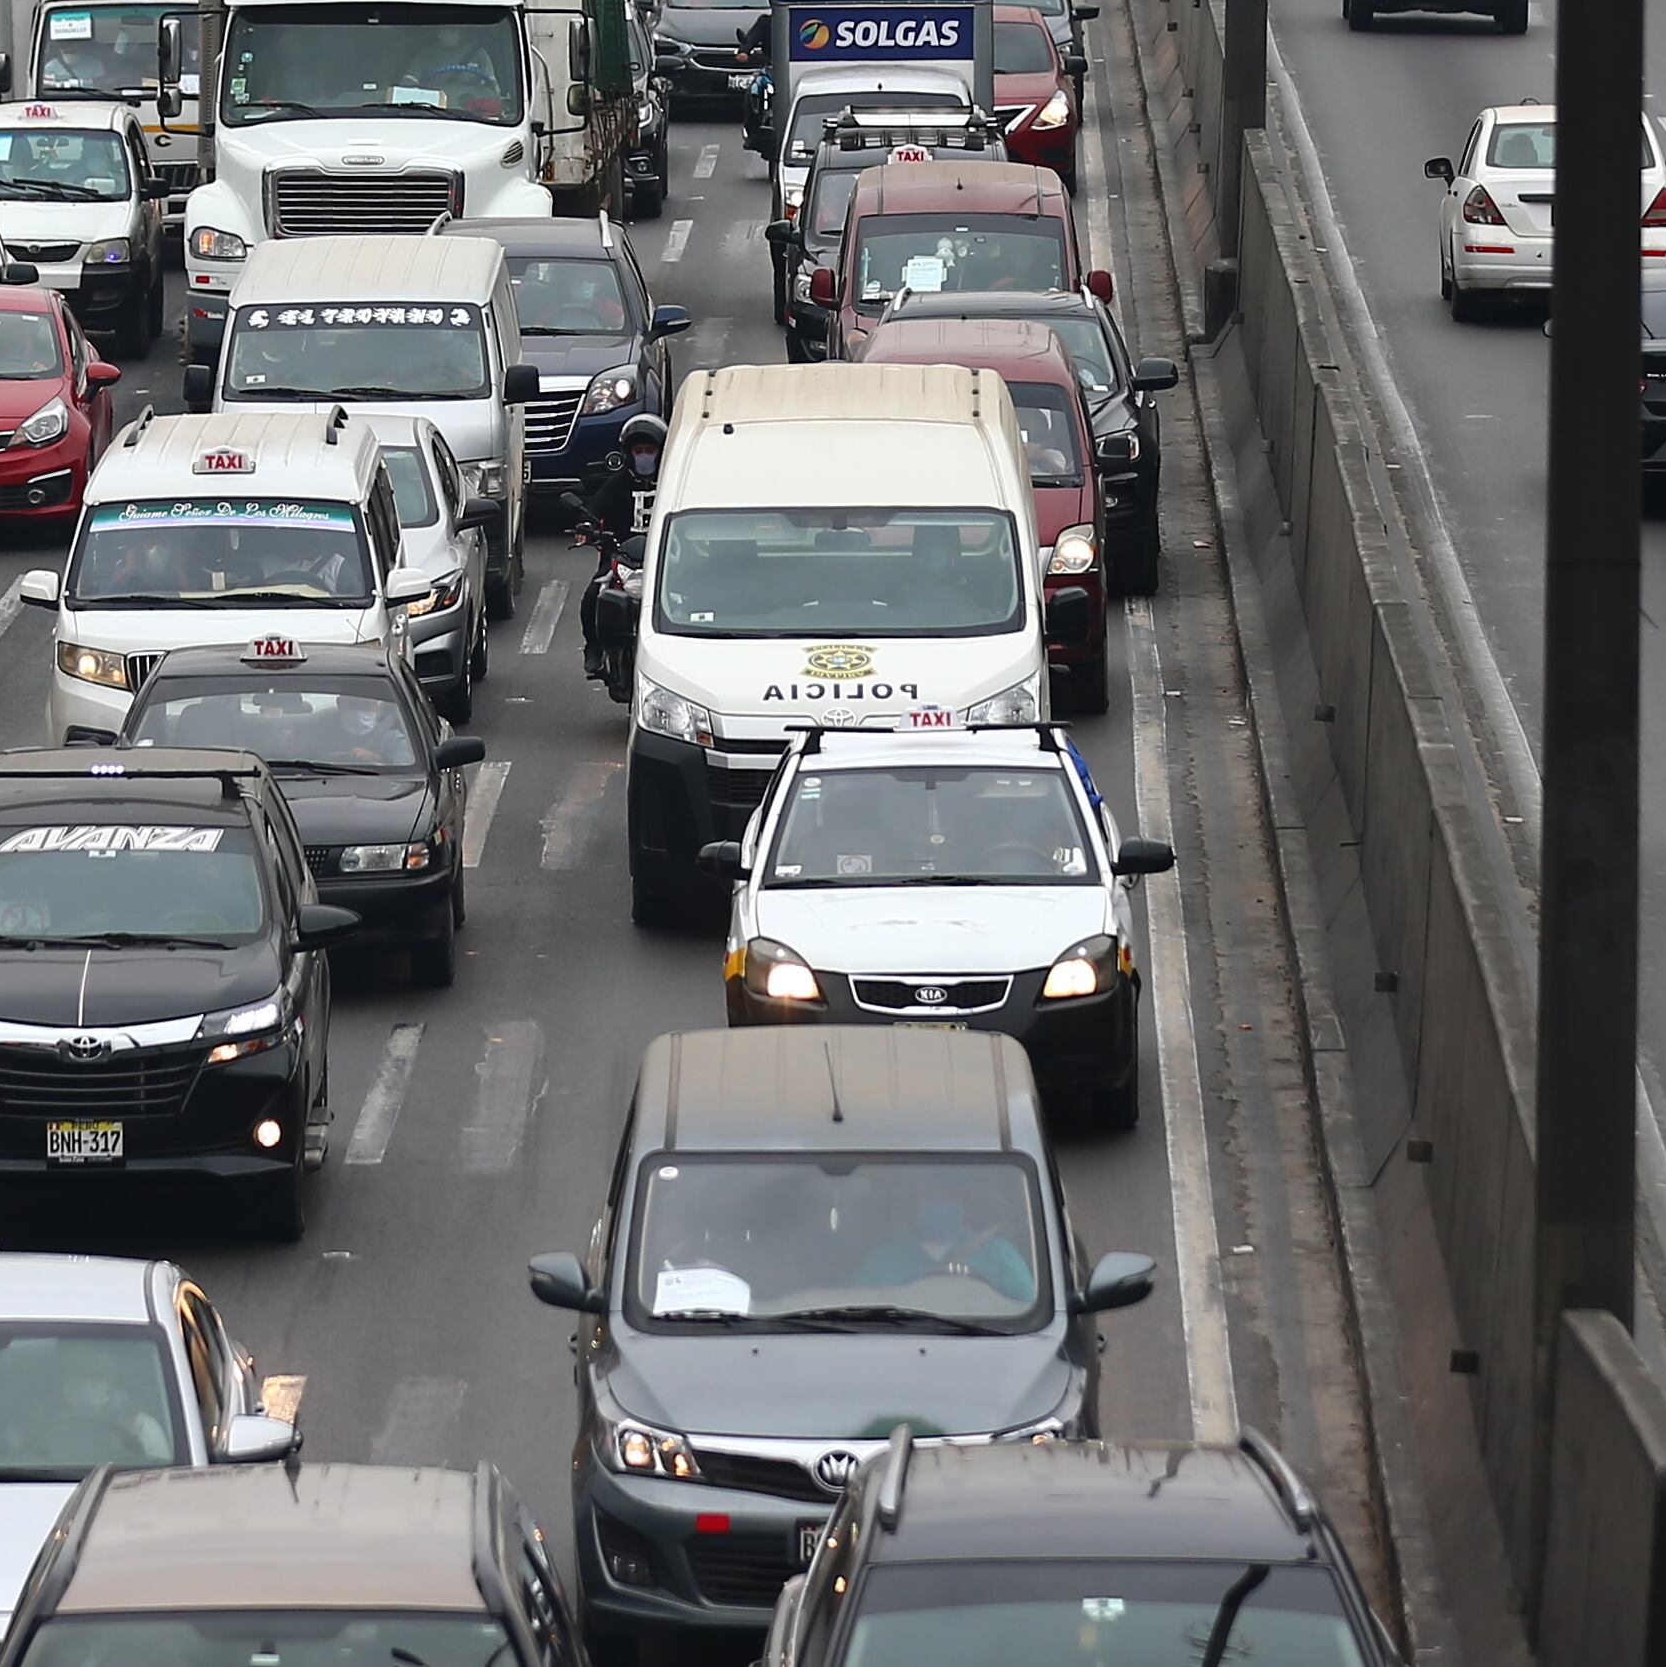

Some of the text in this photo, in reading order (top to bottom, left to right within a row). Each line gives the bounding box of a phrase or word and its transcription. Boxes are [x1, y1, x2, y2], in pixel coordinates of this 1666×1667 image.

[836, 20, 959, 47] SOLGAS
[25, 107, 50, 118] TAXI
[897, 151, 924, 162] TAXI
[205, 455, 243, 469] TAXI
[214, 502, 237, 518] De
[243, 503, 267, 519] Los
[268, 502, 330, 521] Milagros
[254, 641, 294, 656] TAXI
[909, 713, 950, 727] TAXI
[920, 989, 942, 999] KIA
[50, 1130, 120, 1153] BNH-317
